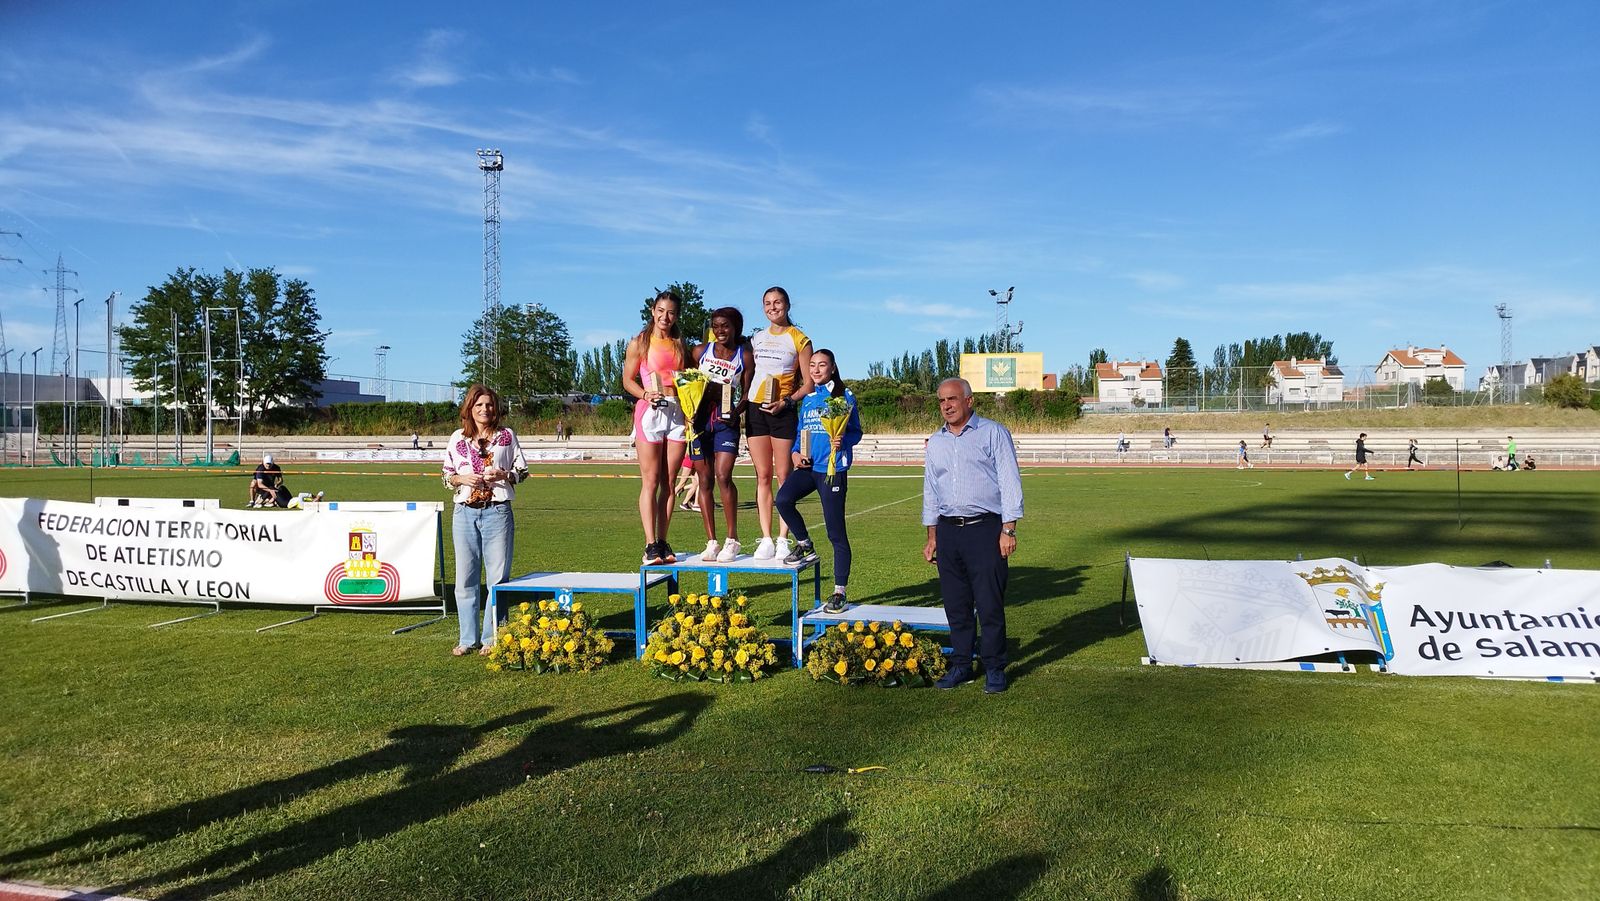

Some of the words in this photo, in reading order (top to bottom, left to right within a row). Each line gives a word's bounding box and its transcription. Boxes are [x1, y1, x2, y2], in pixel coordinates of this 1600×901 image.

[708, 364, 728, 377] 220
[38, 512, 150, 538] FEDERACION
[155, 520, 283, 543] TERRITORIAL
[86, 543, 108, 562] DE
[113, 547, 223, 568] ATLETISMO
[66, 570, 89, 587] DE
[90, 572, 175, 595] CASTILLA
[177, 579, 189, 596] Y
[196, 580, 251, 600] LEON
[712, 572, 722, 593] 1
[1409, 604, 1600, 634] Ayuntami
[1418, 635, 1463, 661] de
[1475, 635, 1600, 658] Salam
